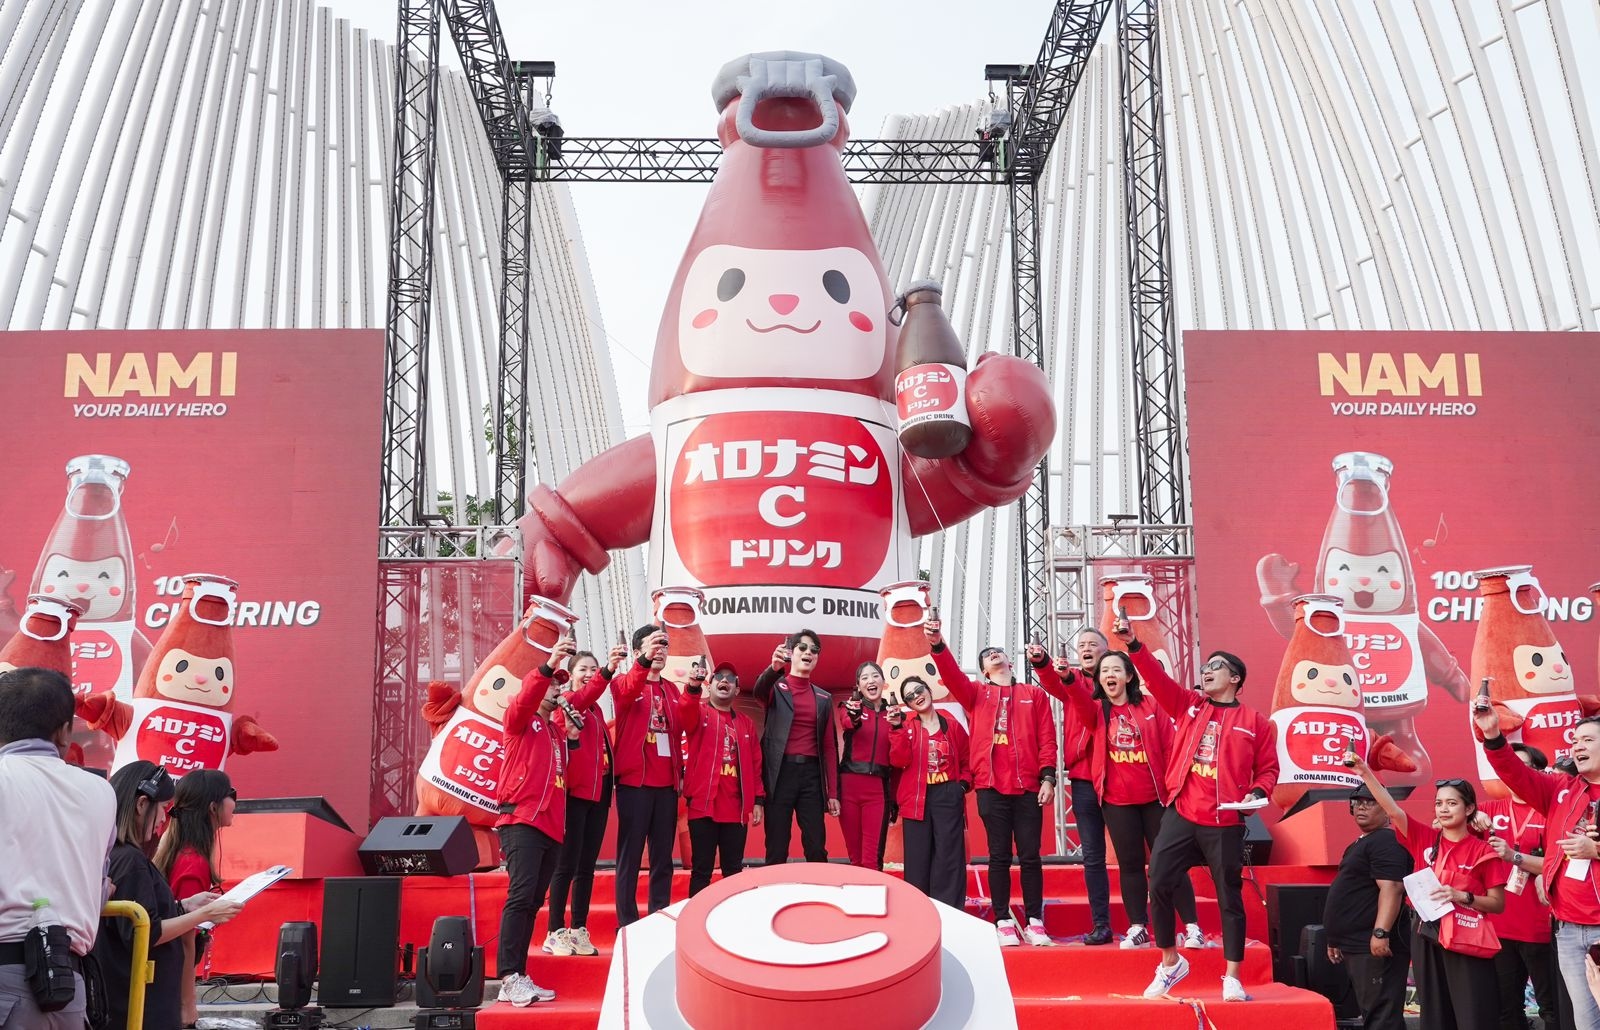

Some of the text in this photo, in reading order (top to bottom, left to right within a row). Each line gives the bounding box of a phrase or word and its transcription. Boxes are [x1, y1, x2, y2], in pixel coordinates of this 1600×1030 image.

[64, 351, 237, 397] NAMI
[1317, 352, 1483, 396] NAMI
[913, 384, 928, 398] C
[73, 402, 227, 417] YOUR DAILY HERO
[907, 398, 940, 413] ドリンク
[1331, 402, 1476, 416] YOUR DAILY HERO
[683, 438, 879, 486] オロナミン
[758, 485, 807, 527] C
[730, 539, 842, 568] ドリンク
[153, 576, 186, 596] 10
[822, 598, 880, 620] DRINK
[1352, 652, 1371, 669] C
[1381, 693, 1409, 704] DRINK
[146, 715, 224, 742] オロナミン
[1292, 721, 1364, 741] オロナミン
[175, 738, 196, 754] C
[454, 725, 505, 760] オロナ
[1323, 737, 1341, 752] C
[159, 755, 205, 770] ドリンク
[473, 754, 493, 771] C
[1312, 755, 1344, 766] ドリン
[454, 765, 497, 790] ドリンク
[1493, 814, 1510, 830] C
[704, 882, 890, 967] C
